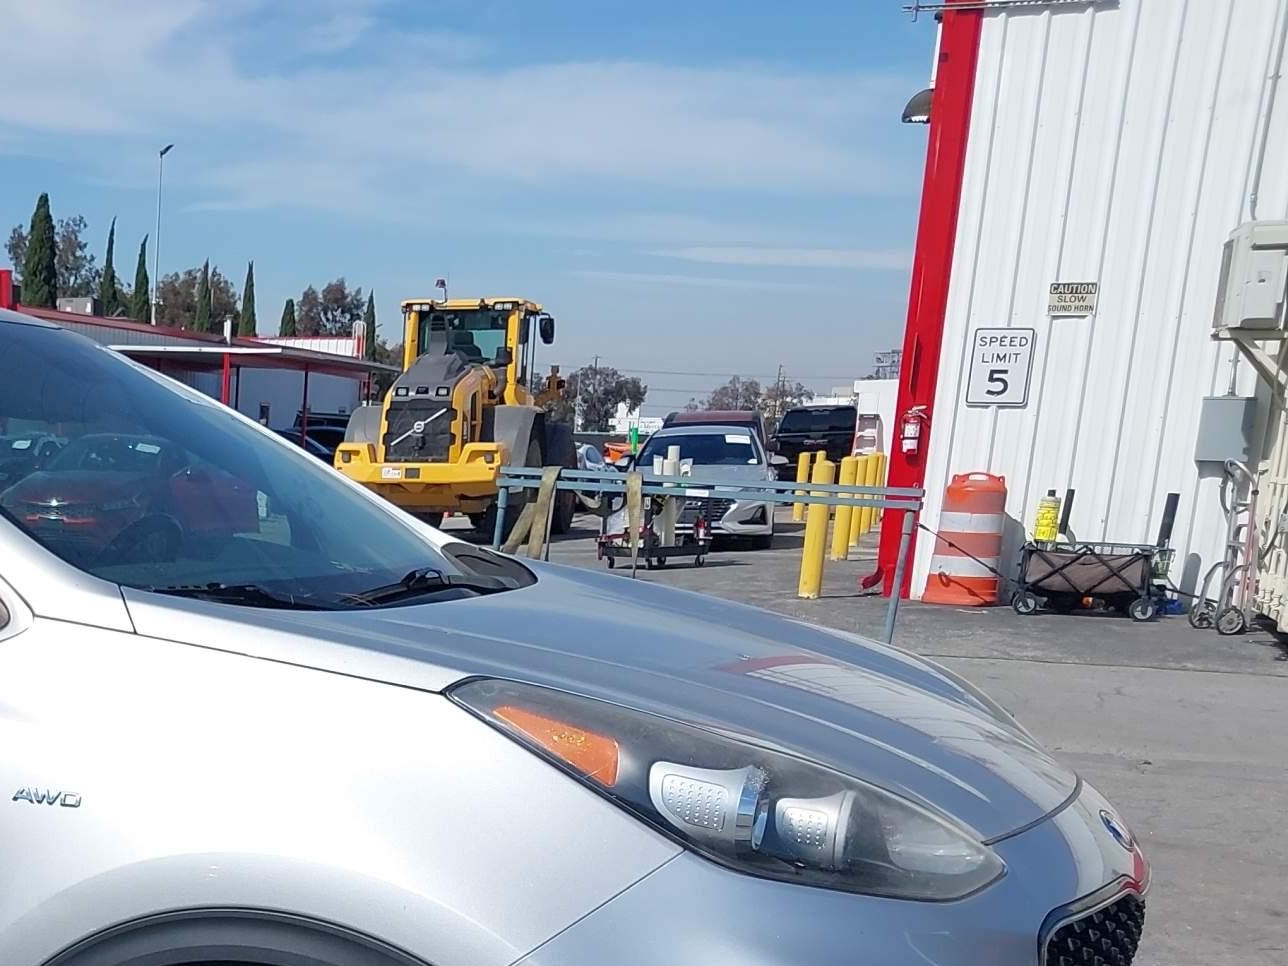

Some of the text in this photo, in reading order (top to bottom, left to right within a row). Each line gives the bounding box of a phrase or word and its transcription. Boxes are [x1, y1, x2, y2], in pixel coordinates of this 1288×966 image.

[1051, 284, 1096, 294] CAUTION
[1057, 295, 1087, 303] SLOW
[1048, 304, 1094, 312] SOUND HORN
[979, 336, 1029, 347] SPEED
[982, 353, 1021, 364] LIMIT
[985, 369, 1009, 396] 5
[12, 787, 81, 808] AWD
